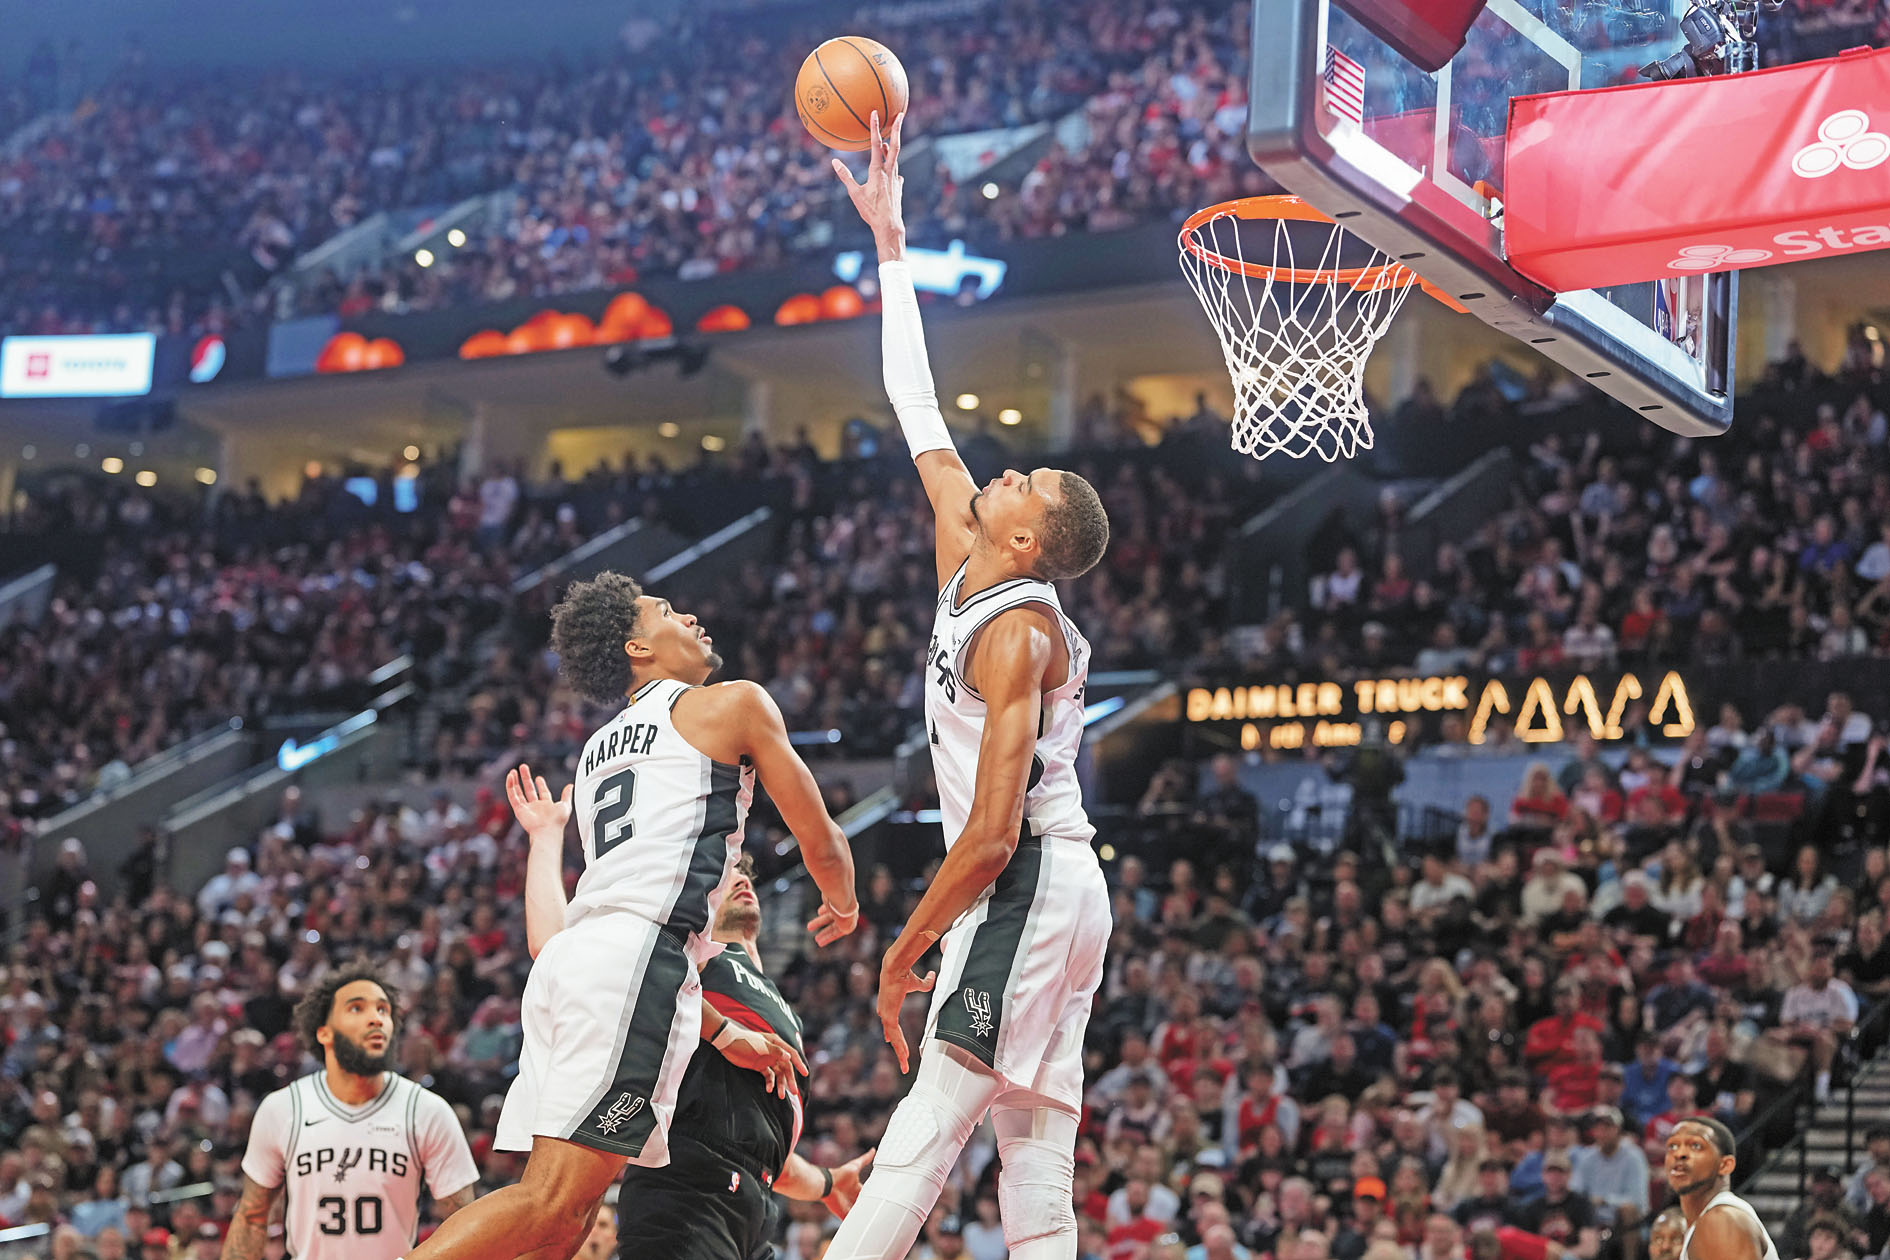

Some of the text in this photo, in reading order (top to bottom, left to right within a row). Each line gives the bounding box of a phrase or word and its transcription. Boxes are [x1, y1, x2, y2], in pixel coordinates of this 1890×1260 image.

[1773, 223, 1890, 255] Sta
[1187, 675, 1469, 721] DAIMLER TRUCK
[585, 723, 658, 777] HARPER
[591, 765, 638, 862] 2
[297, 1147, 409, 1184] SPURS
[319, 1196, 382, 1236] 30
